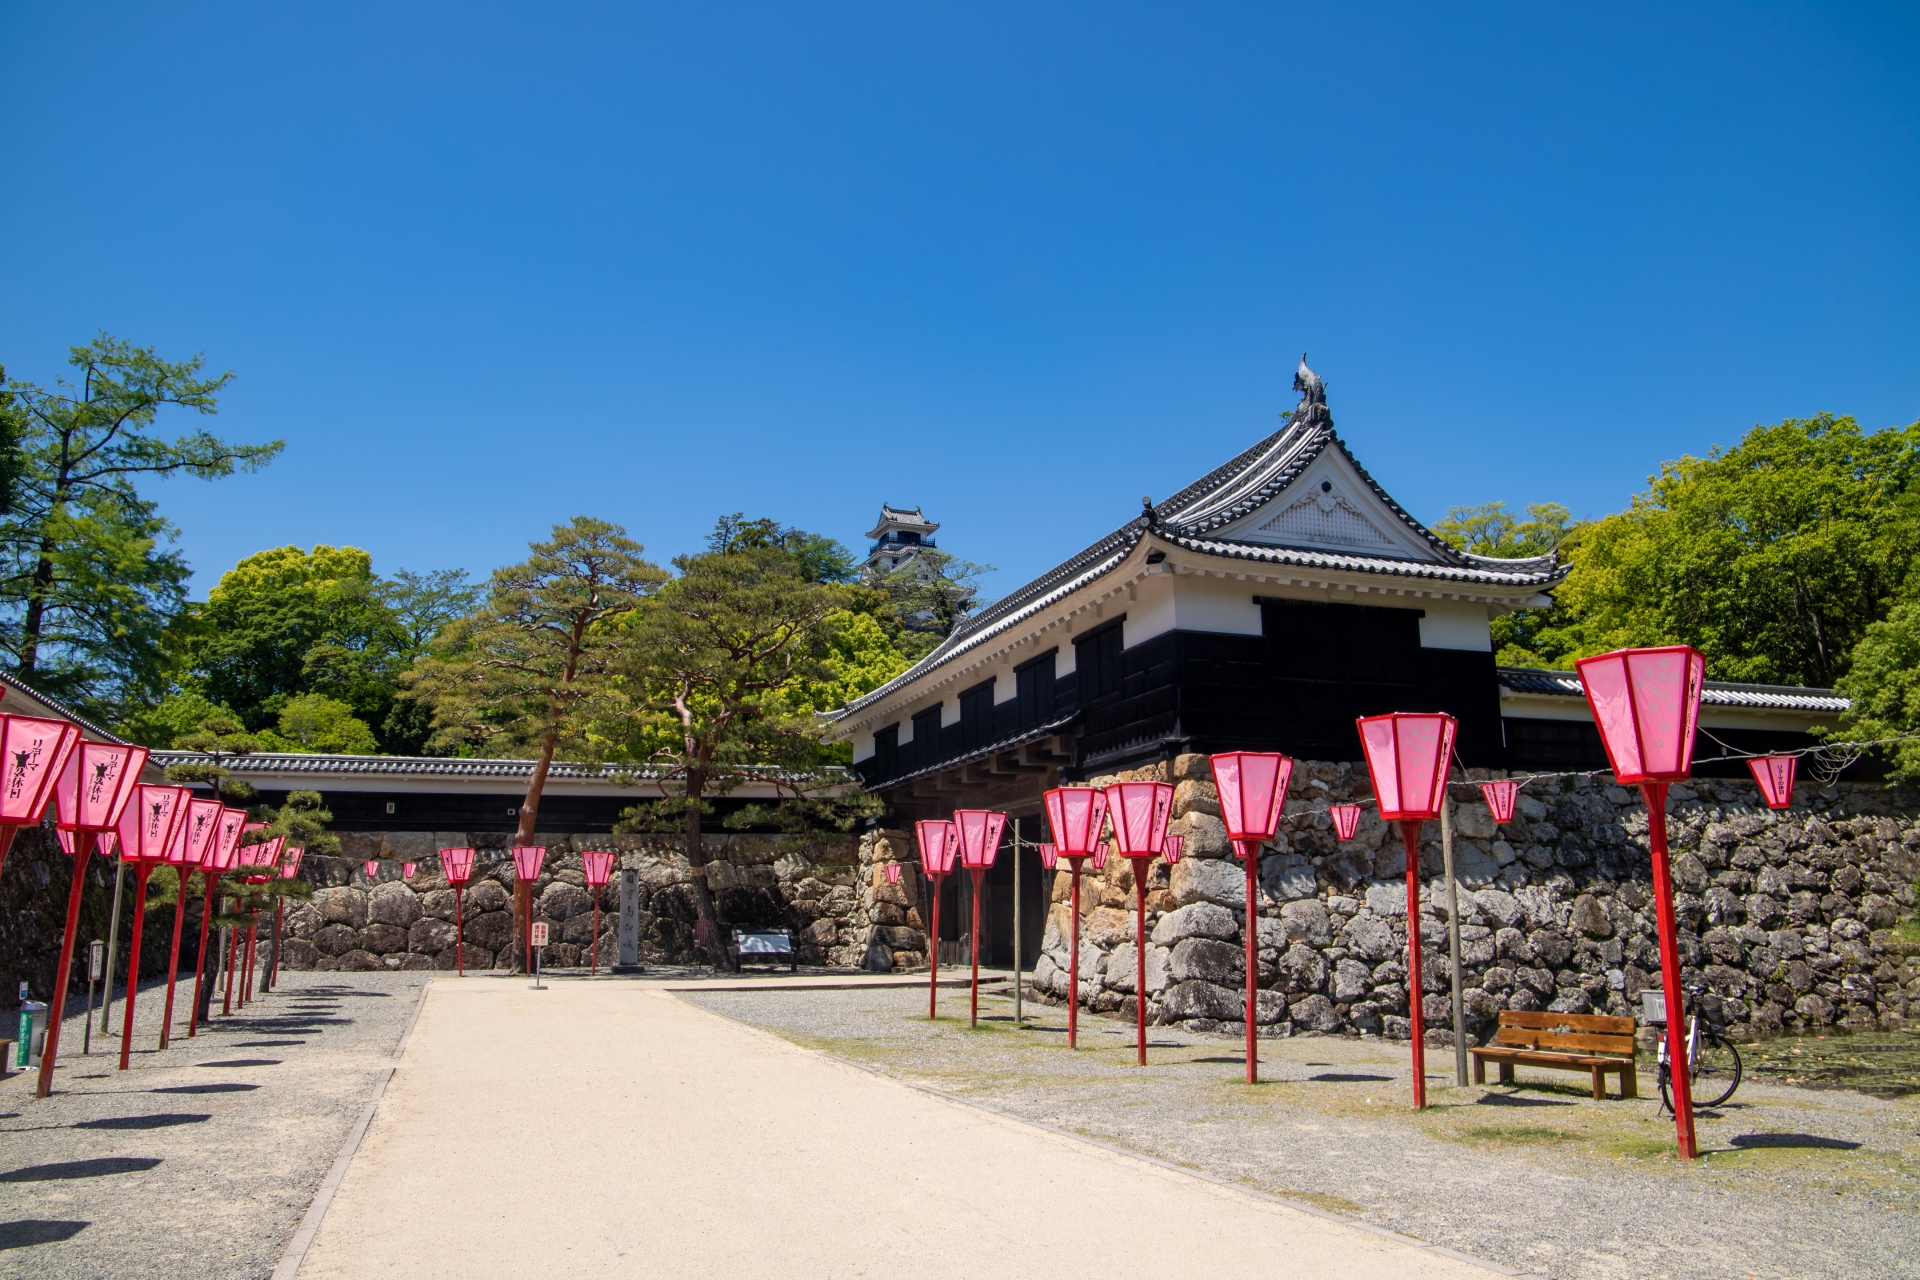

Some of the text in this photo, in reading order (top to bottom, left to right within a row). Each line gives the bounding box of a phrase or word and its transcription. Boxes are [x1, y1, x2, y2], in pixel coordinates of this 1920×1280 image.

[28, 739, 43, 771] リョーマ
[105, 754, 118, 781] リョーマ
[9, 767, 25, 799] の休日
